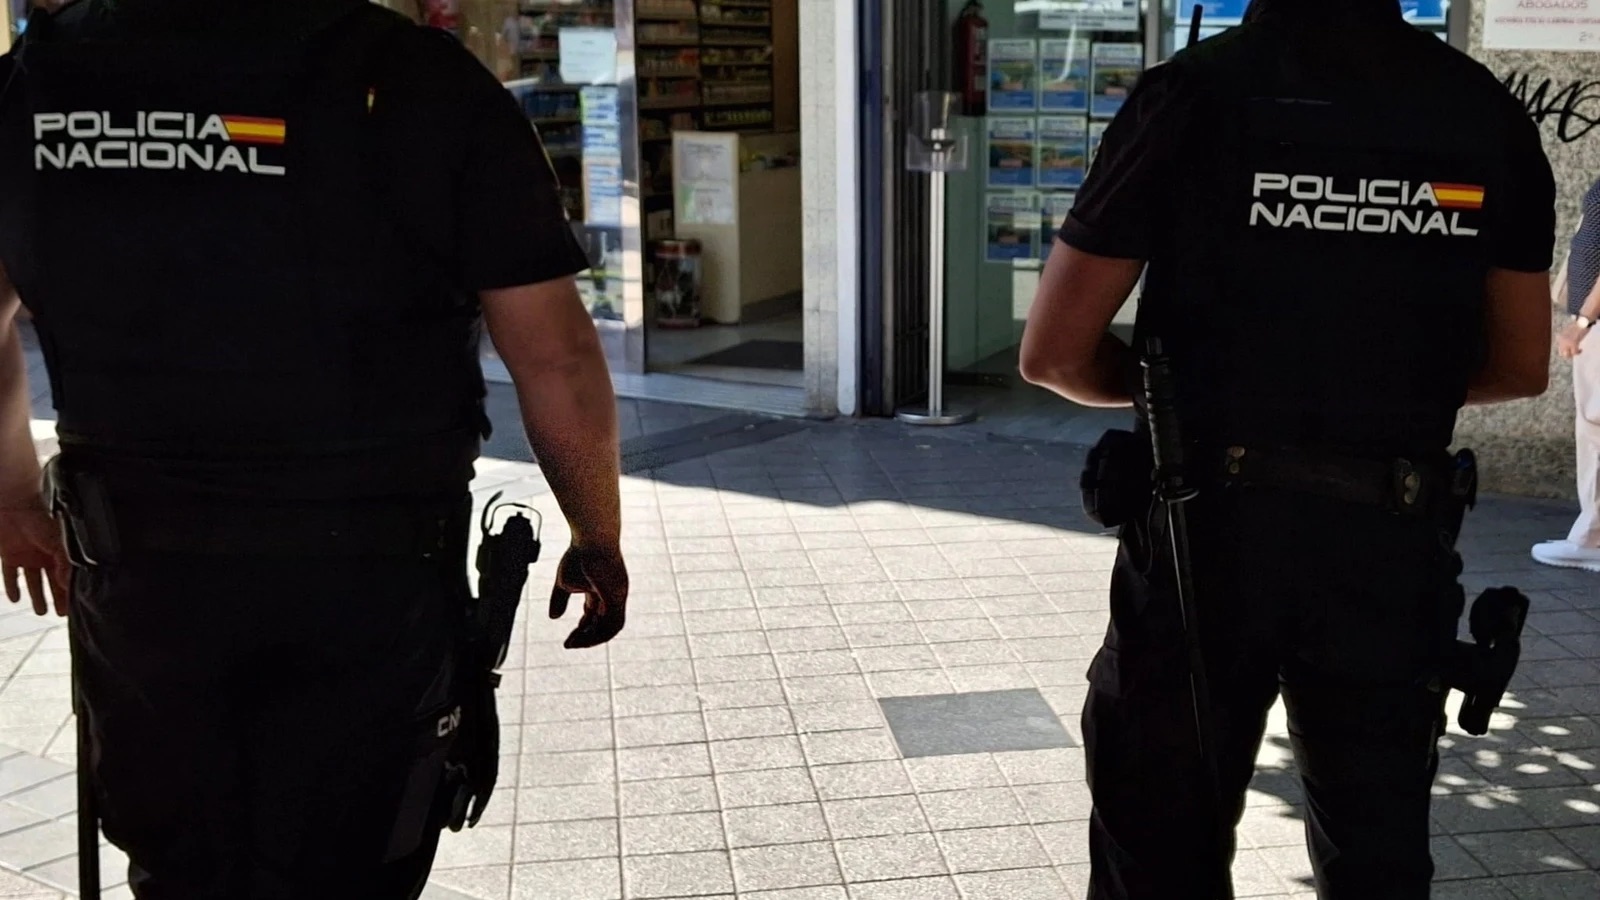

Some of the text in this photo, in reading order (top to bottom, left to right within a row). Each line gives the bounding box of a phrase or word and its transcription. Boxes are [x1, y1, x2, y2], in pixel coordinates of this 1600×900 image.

[1517, 0, 1588, 9] ABOGADOS
[33, 110, 230, 141] POLICIA
[34, 140, 286, 176] NACIONAL
[1249, 201, 1479, 236] NACIONAL
